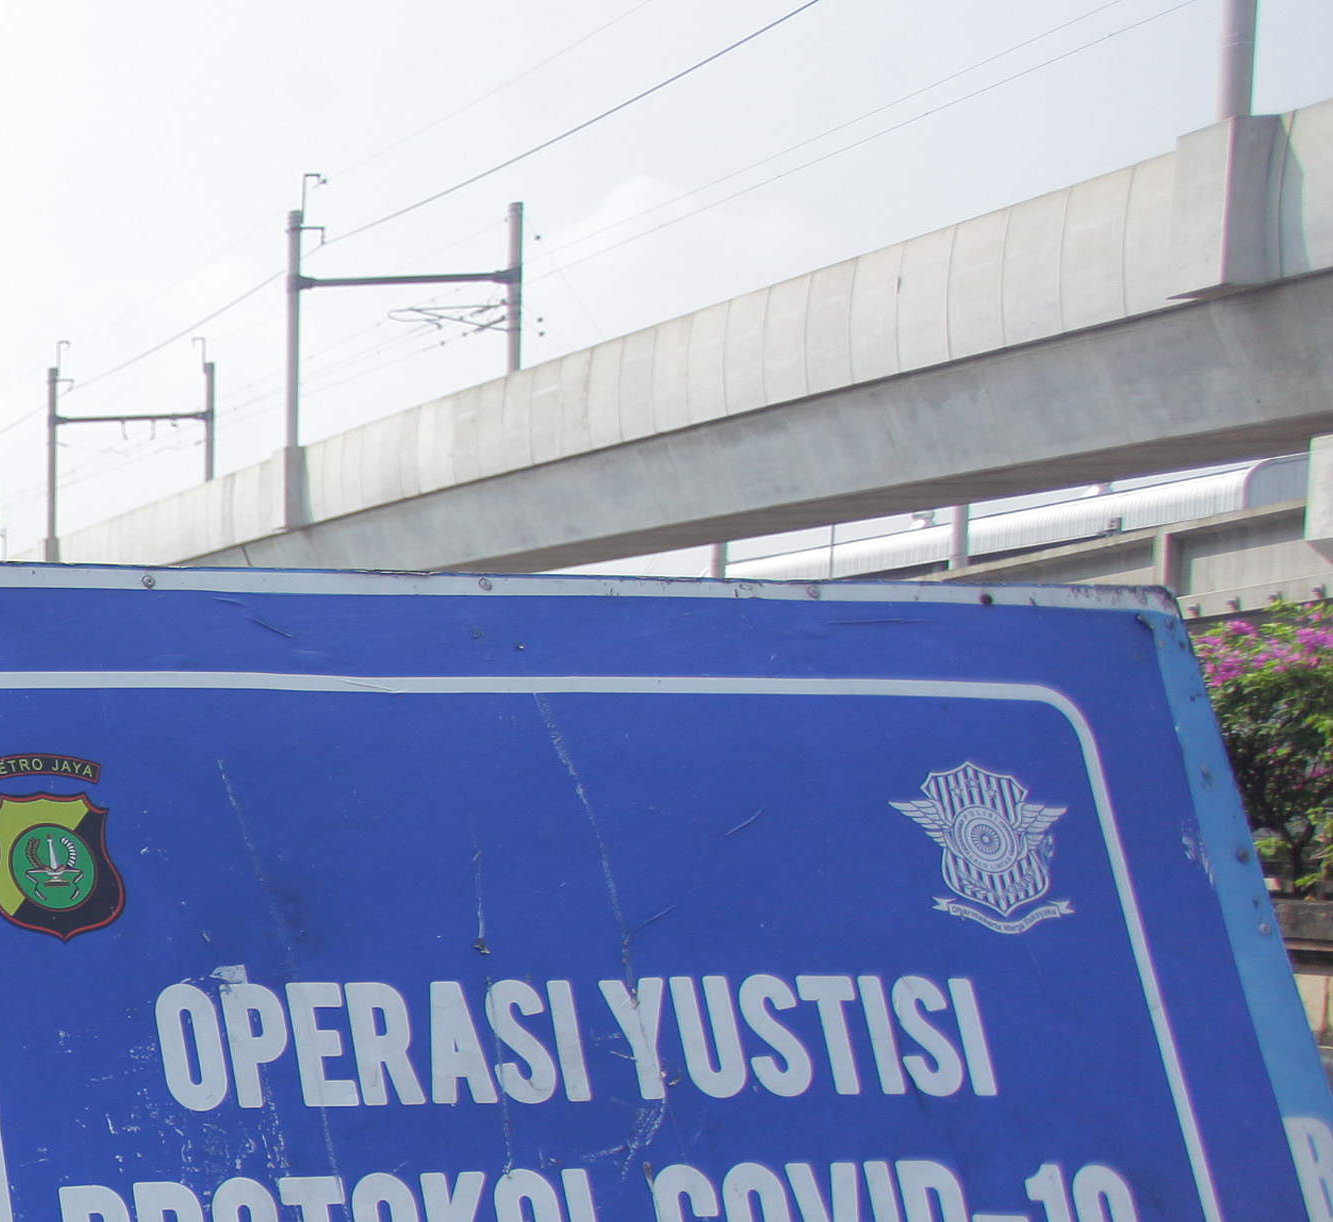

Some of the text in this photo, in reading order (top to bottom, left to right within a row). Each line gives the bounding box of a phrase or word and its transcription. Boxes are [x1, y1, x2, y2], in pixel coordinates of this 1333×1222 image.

[51, 759, 93, 777] JAYA
[155, 974, 997, 1111] OPERASI YUSTISI
